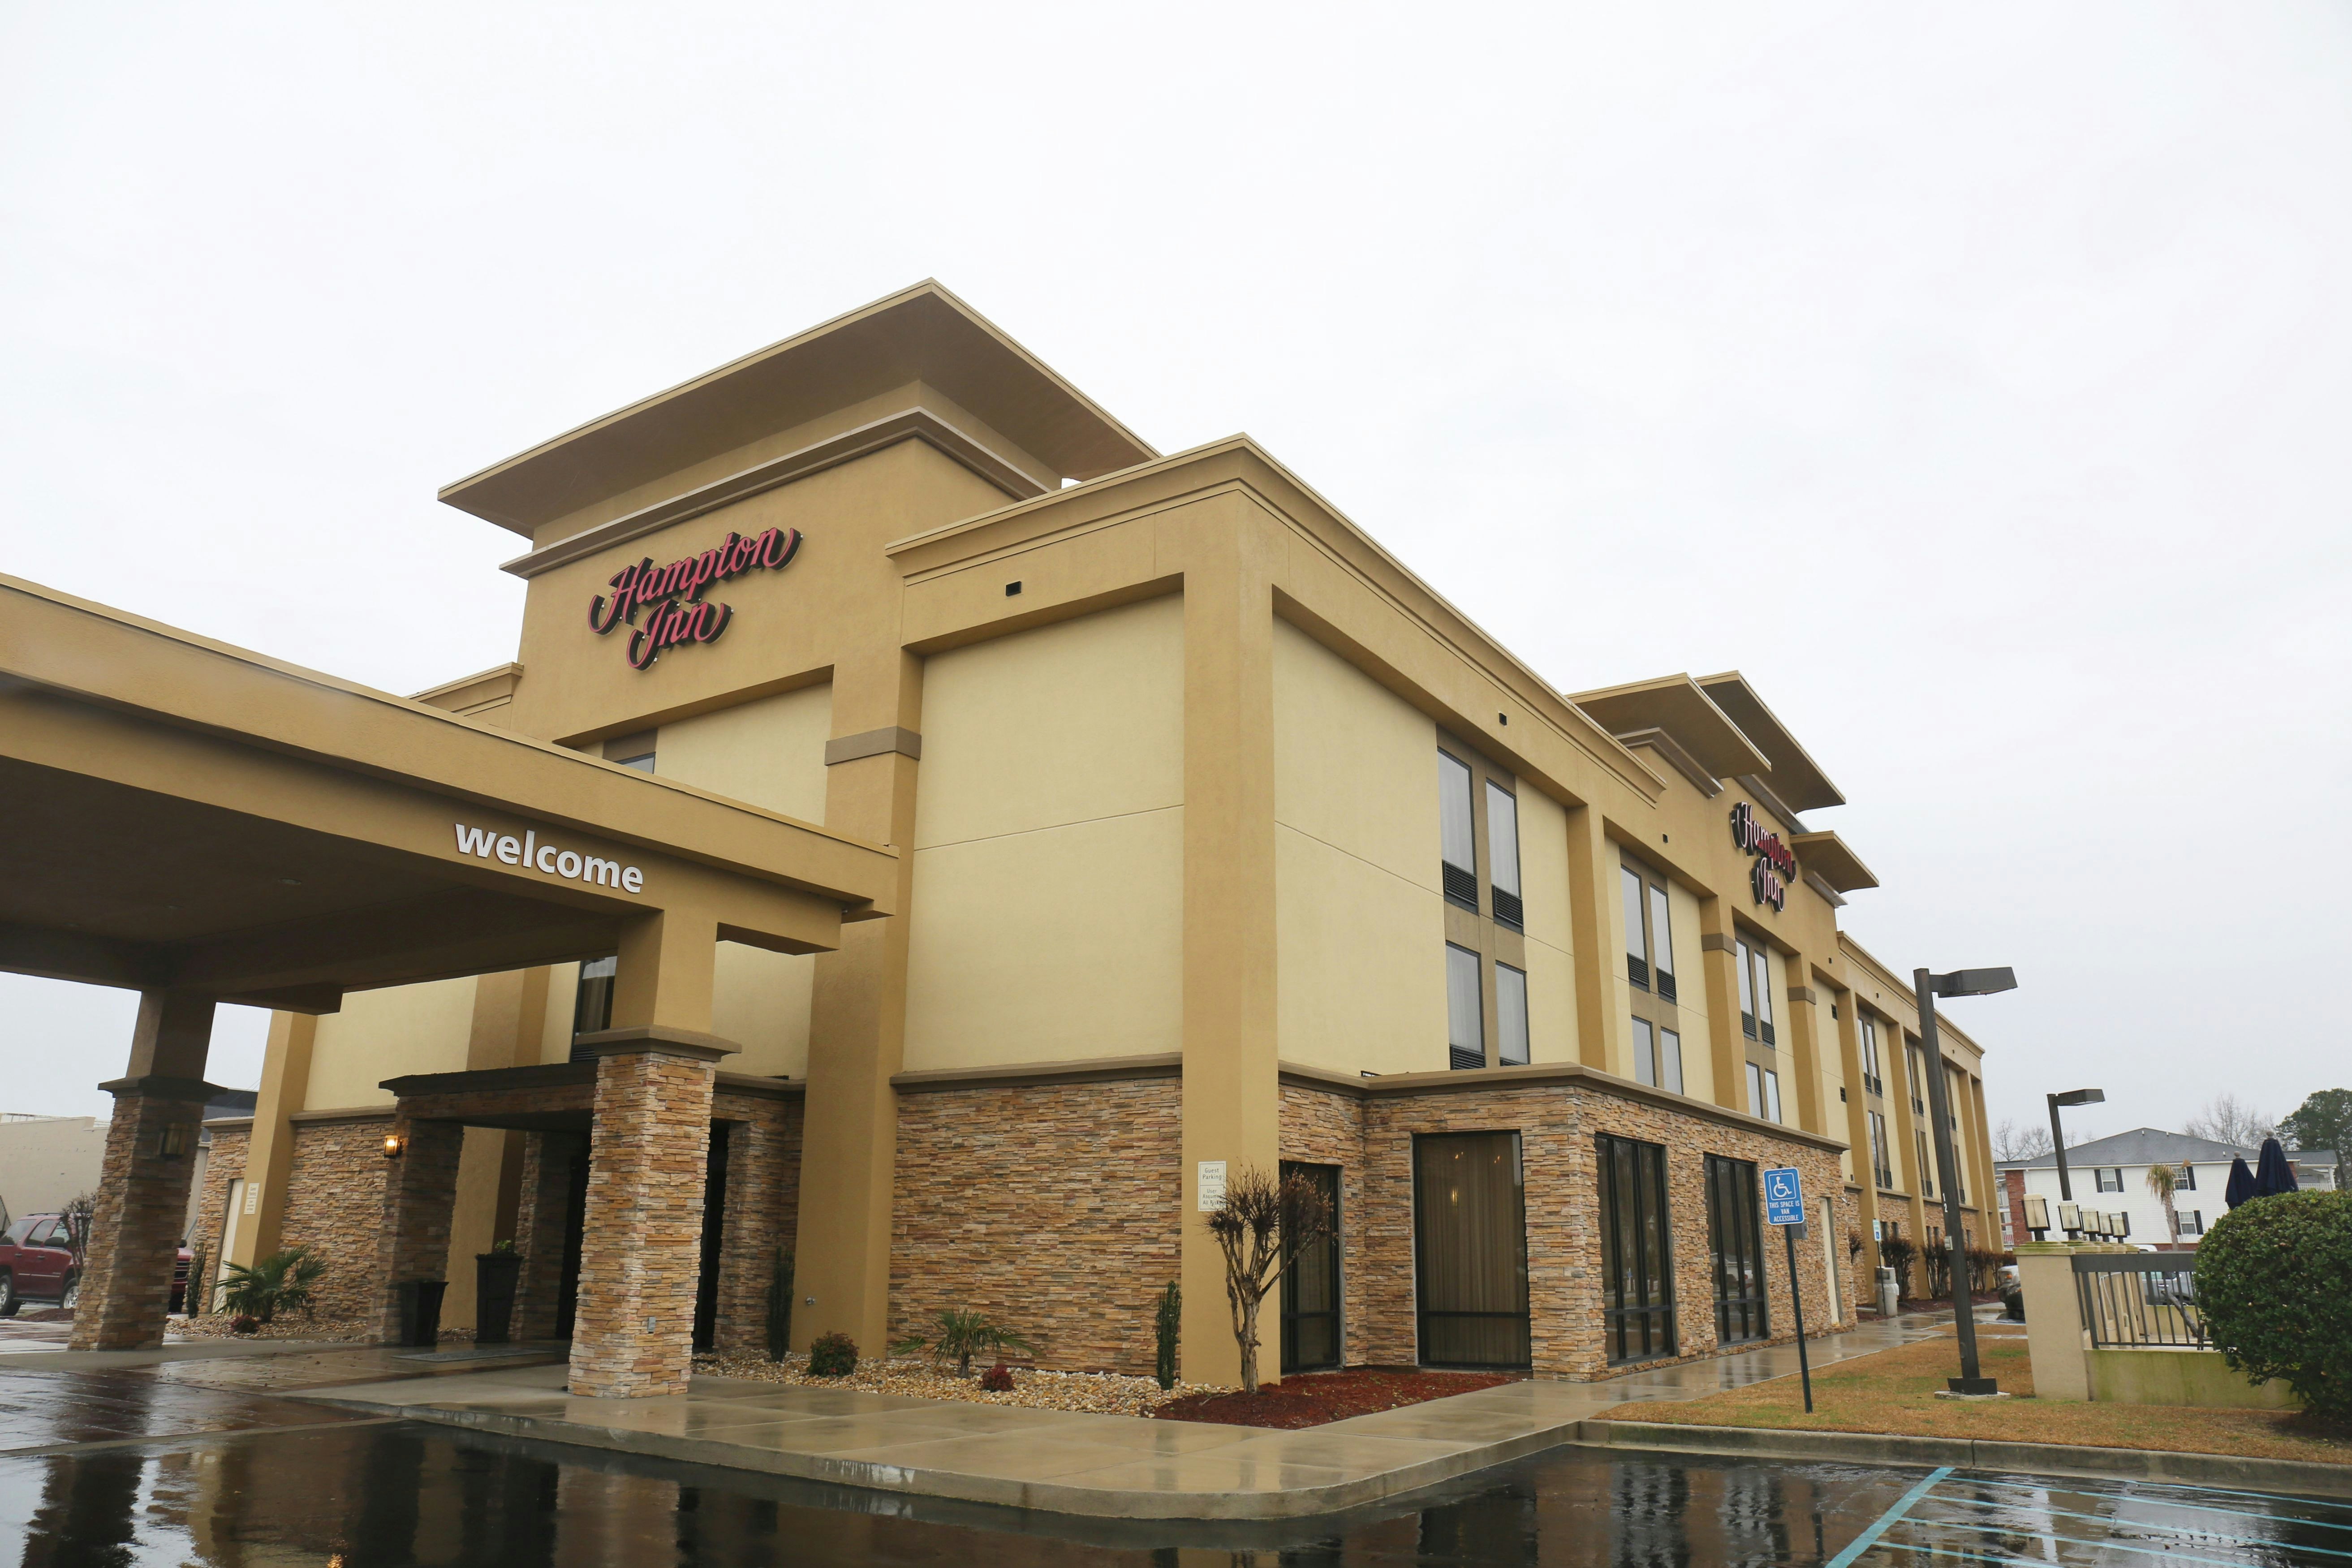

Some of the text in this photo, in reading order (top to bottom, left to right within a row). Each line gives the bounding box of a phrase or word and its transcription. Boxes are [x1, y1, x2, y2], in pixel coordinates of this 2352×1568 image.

[588, 527, 801, 635] Hampton
[627, 599, 731, 671] Inn
[455, 823, 643, 893] welcome
[1751, 857, 1784, 912] Inn
[1774, 1215, 1800, 1223] ACCESSIBLE
